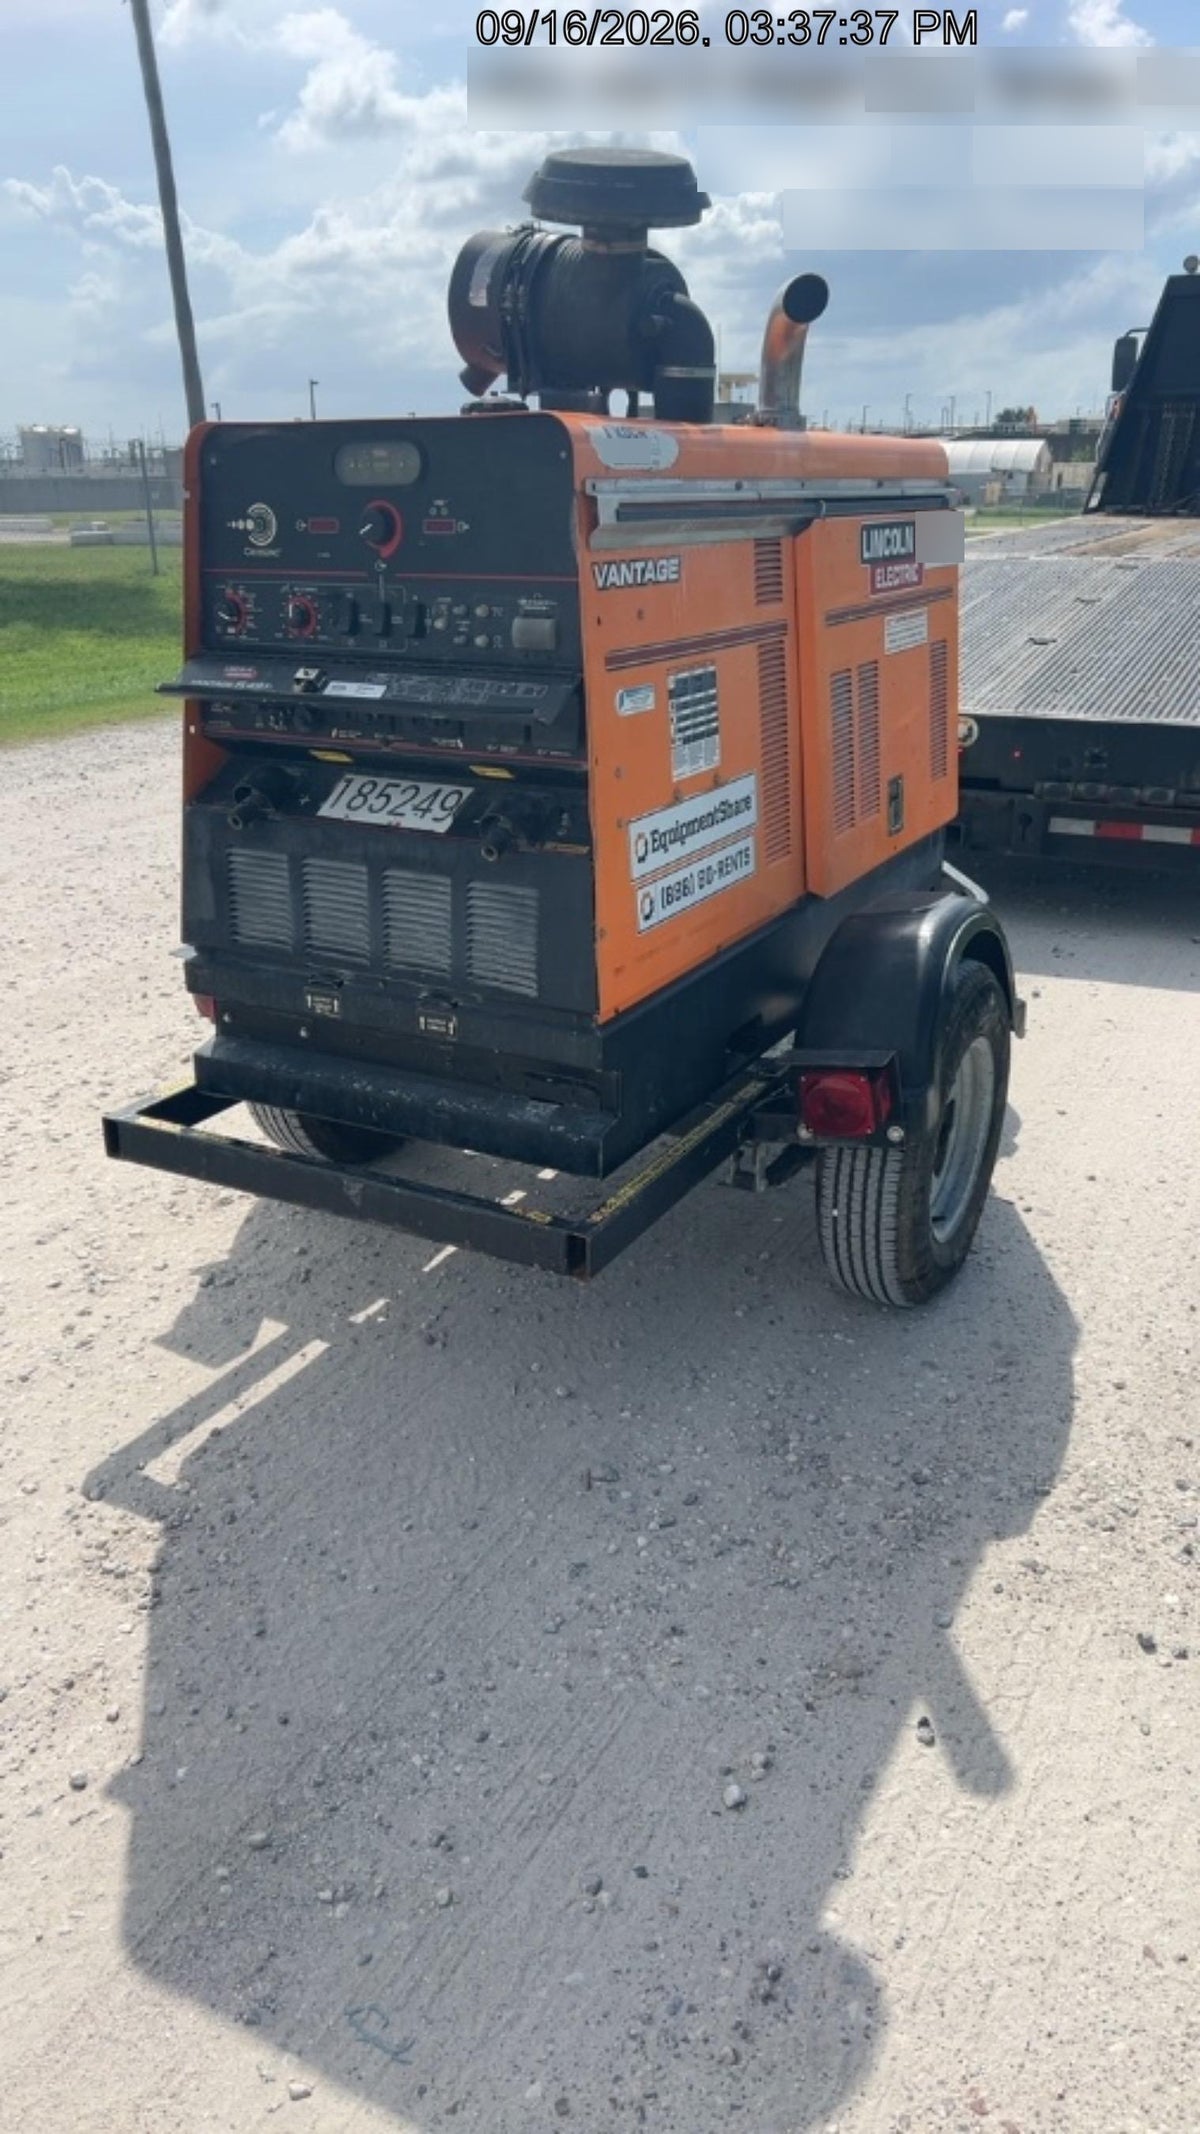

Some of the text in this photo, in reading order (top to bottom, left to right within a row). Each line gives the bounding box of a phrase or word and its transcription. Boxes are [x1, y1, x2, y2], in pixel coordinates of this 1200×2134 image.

[863, 526, 914, 560] LINCOLN
[593, 557, 680, 590] VANTAGE
[874, 562, 920, 589] ELECTRIC
[328, 776, 464, 822] 185249
[649, 794, 753, 854] EquipmentShare
